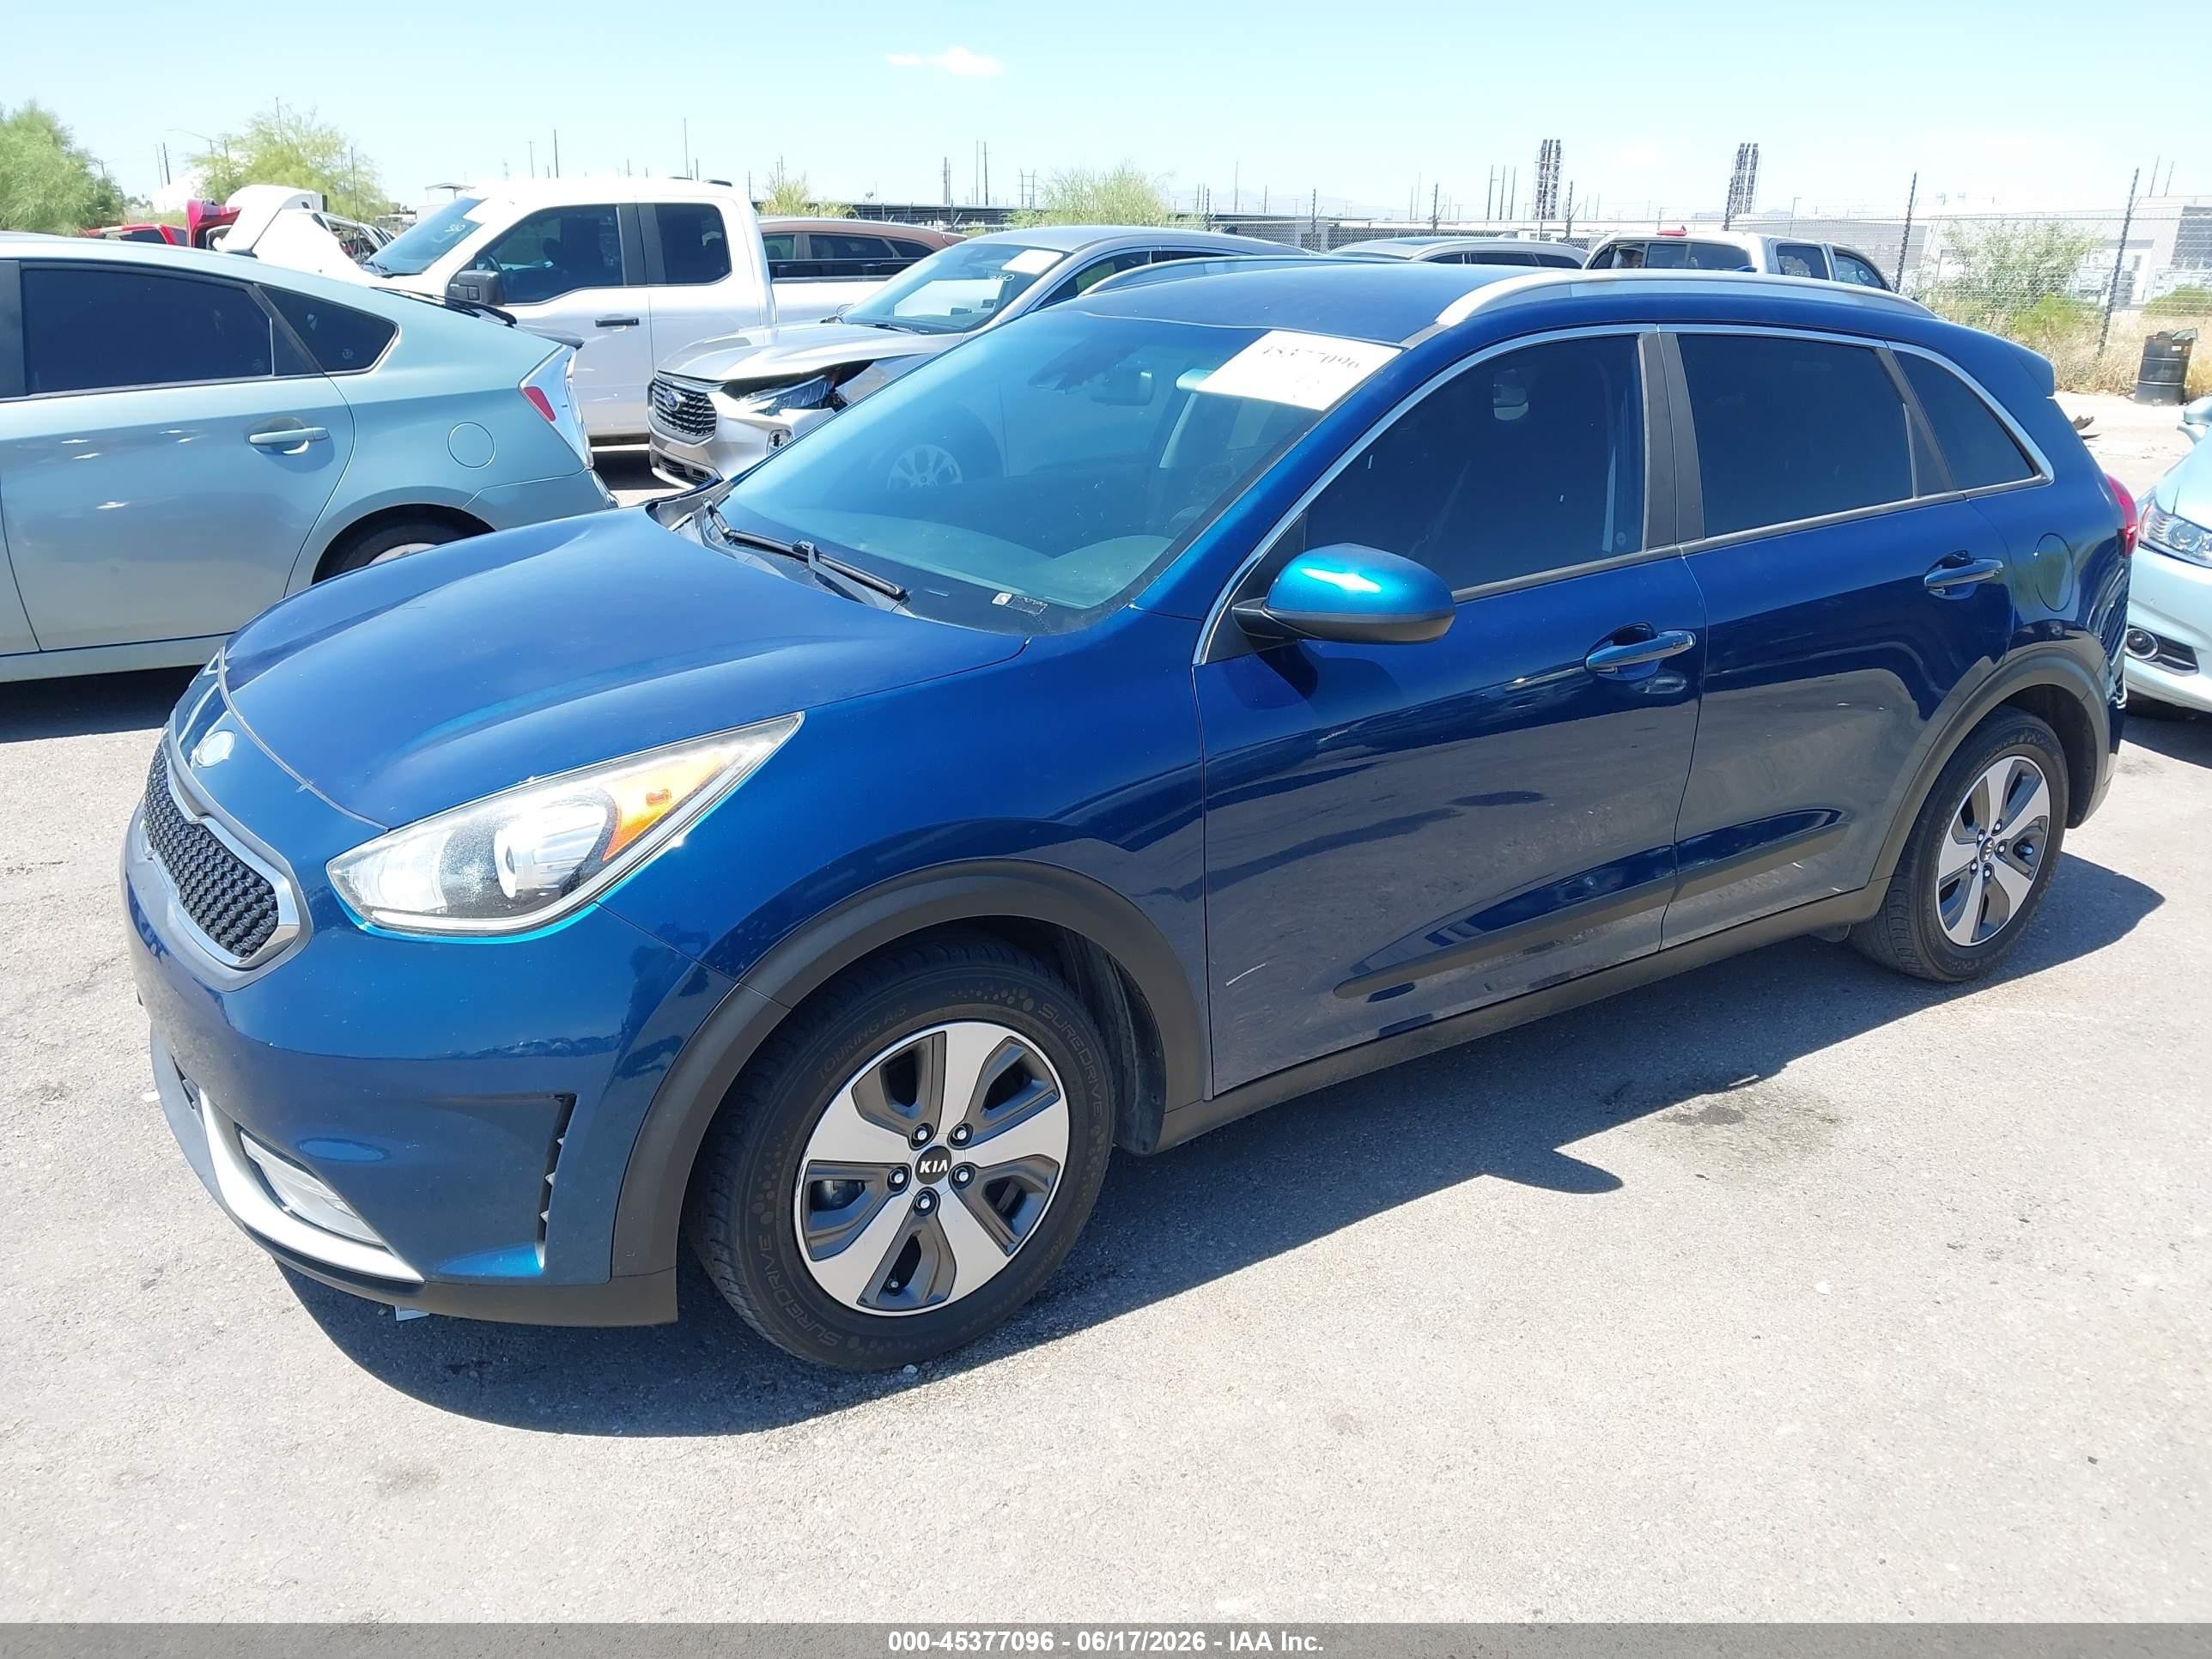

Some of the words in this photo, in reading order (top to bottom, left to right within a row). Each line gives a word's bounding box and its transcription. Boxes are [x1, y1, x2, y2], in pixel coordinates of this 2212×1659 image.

[1984, 840, 1993, 861] KIA
[1037, 1002, 1103, 1116] SUREDRIVE
[920, 1159, 948, 1173] KIA
